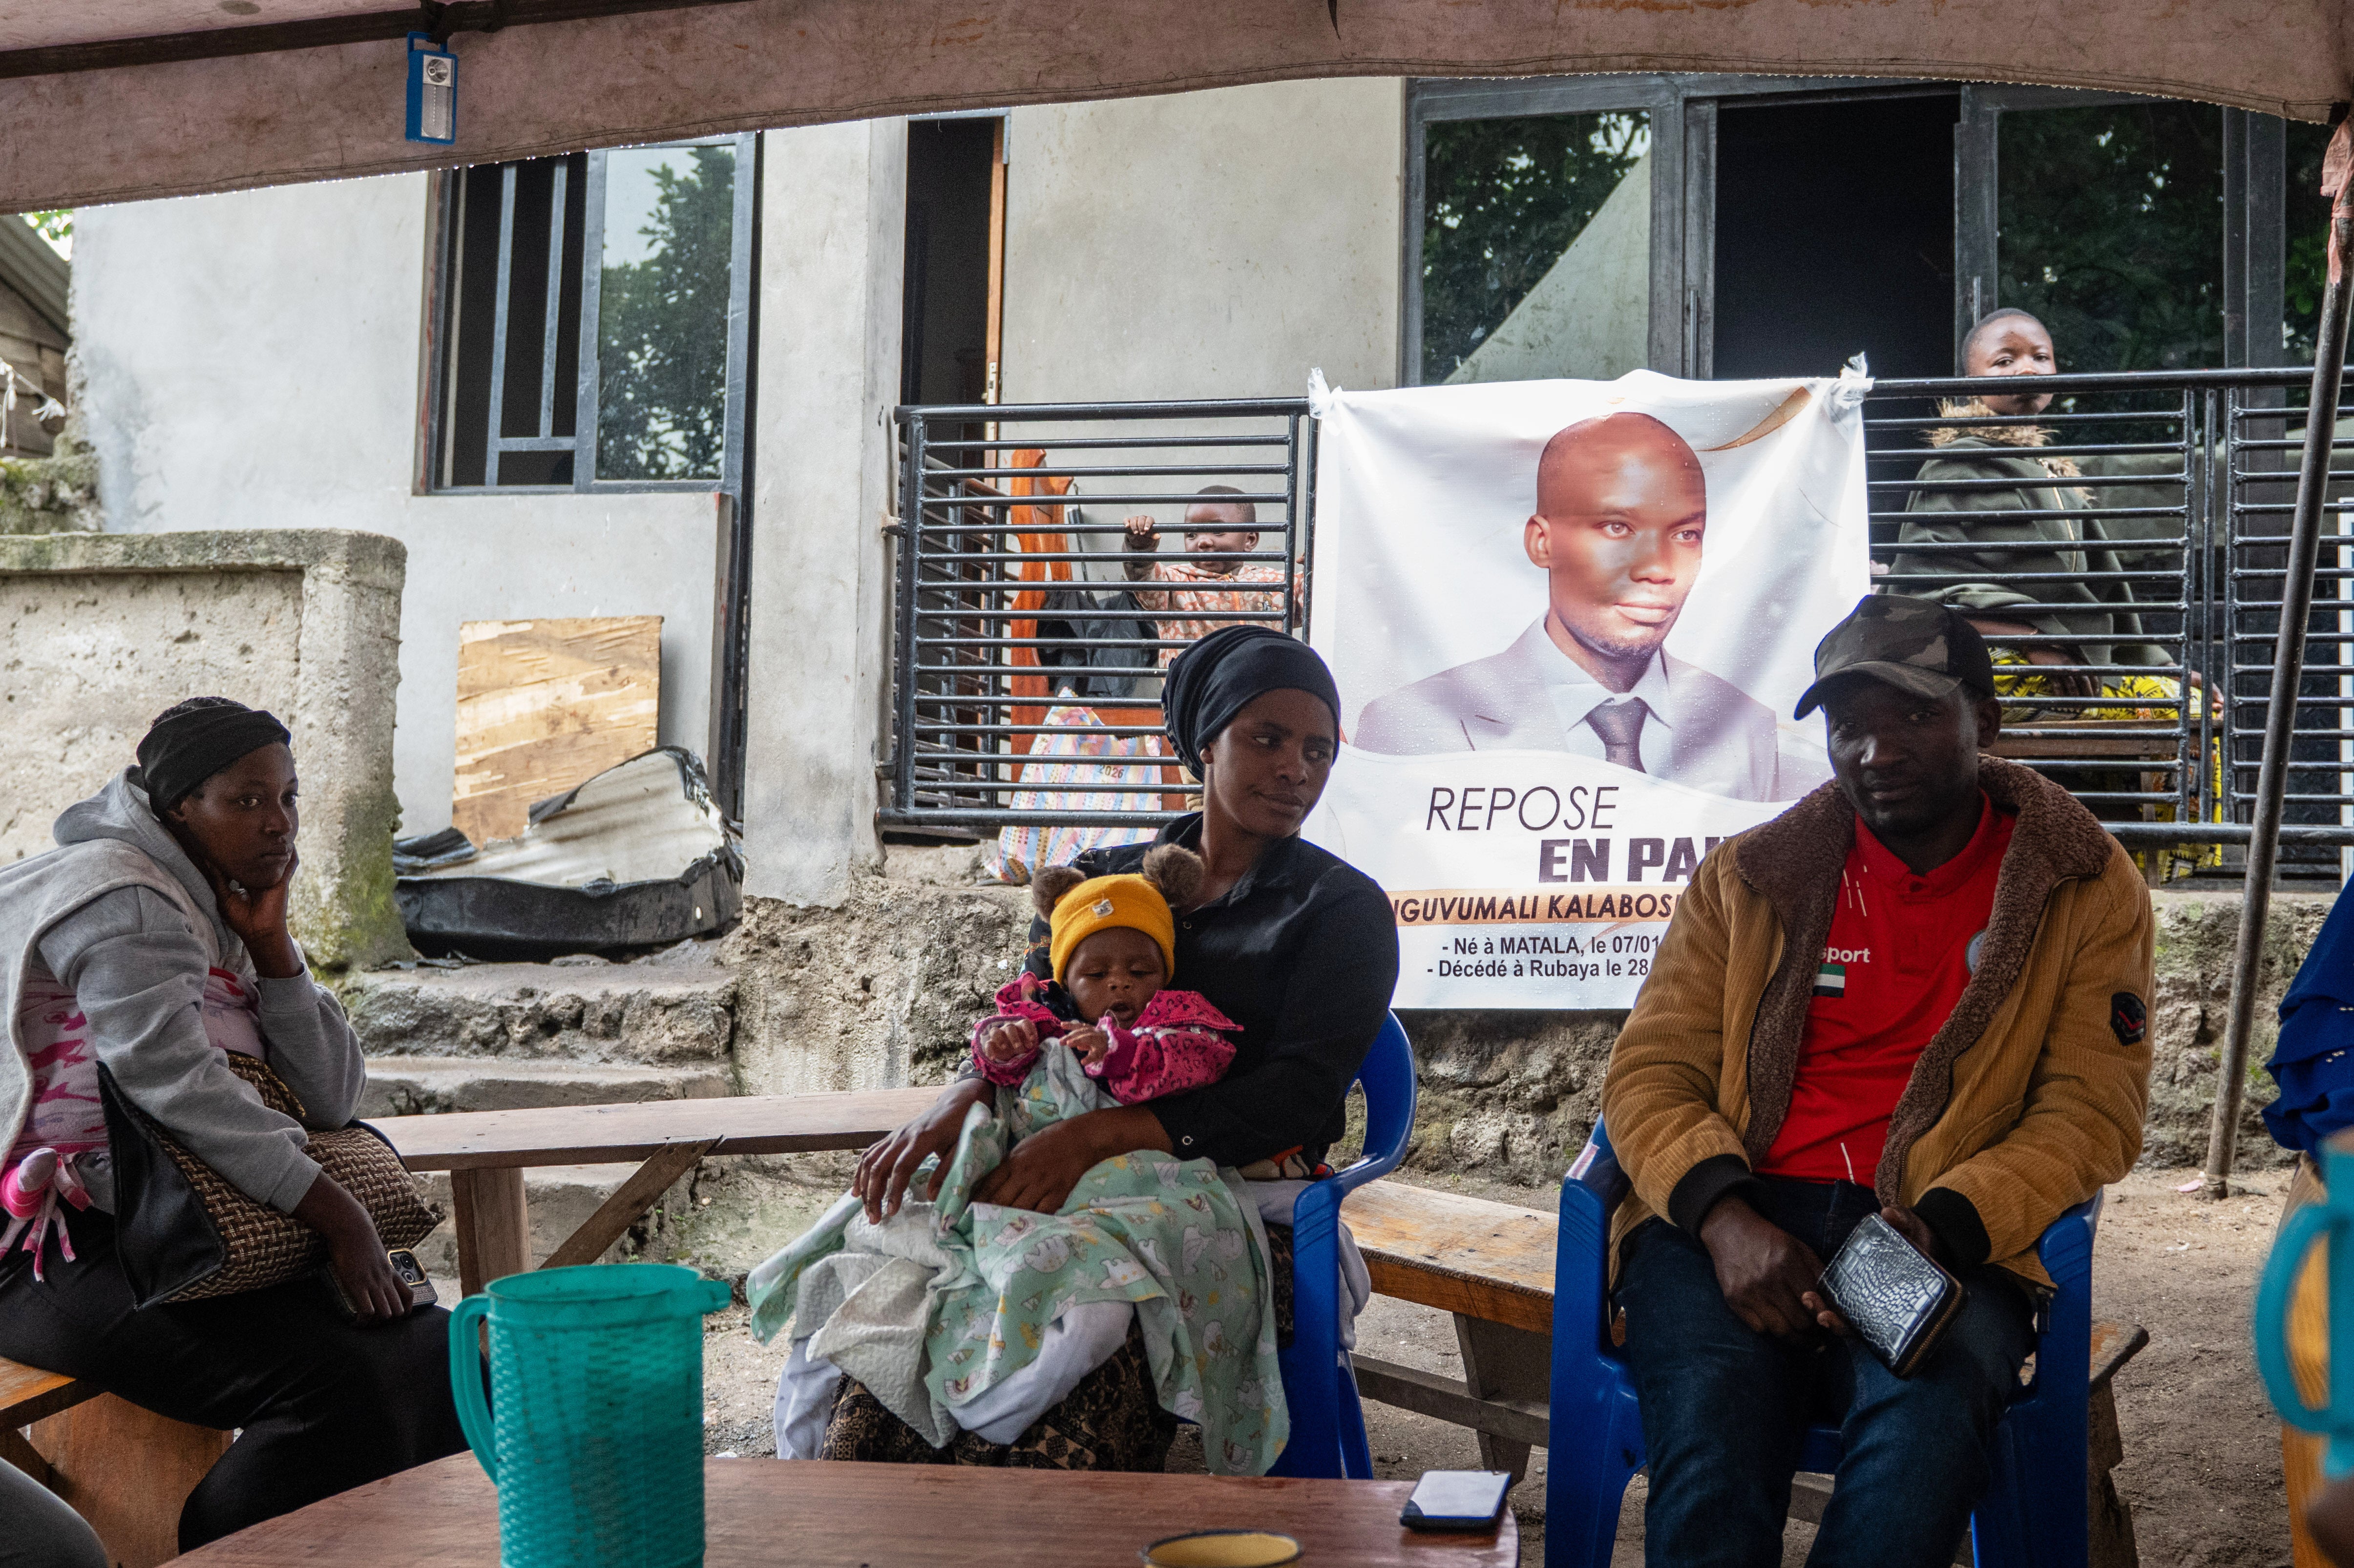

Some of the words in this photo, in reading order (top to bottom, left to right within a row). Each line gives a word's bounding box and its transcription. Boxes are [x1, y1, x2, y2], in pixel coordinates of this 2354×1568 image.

[1427, 786, 1619, 831] REPOSE
[1539, 838, 1610, 882] EN
[1627, 836, 1731, 882] PA
[1547, 894, 1681, 920] KALABOS
[1454, 937, 1478, 955] Né
[1484, 937, 1493, 955] à
[1500, 937, 1584, 957] MATALA,
[1591, 937, 1606, 953] le
[1439, 960, 1508, 977] Décédé
[1513, 959, 1524, 977] à
[1530, 960, 1599, 981] Rubaya
[1606, 959, 1621, 976] le
